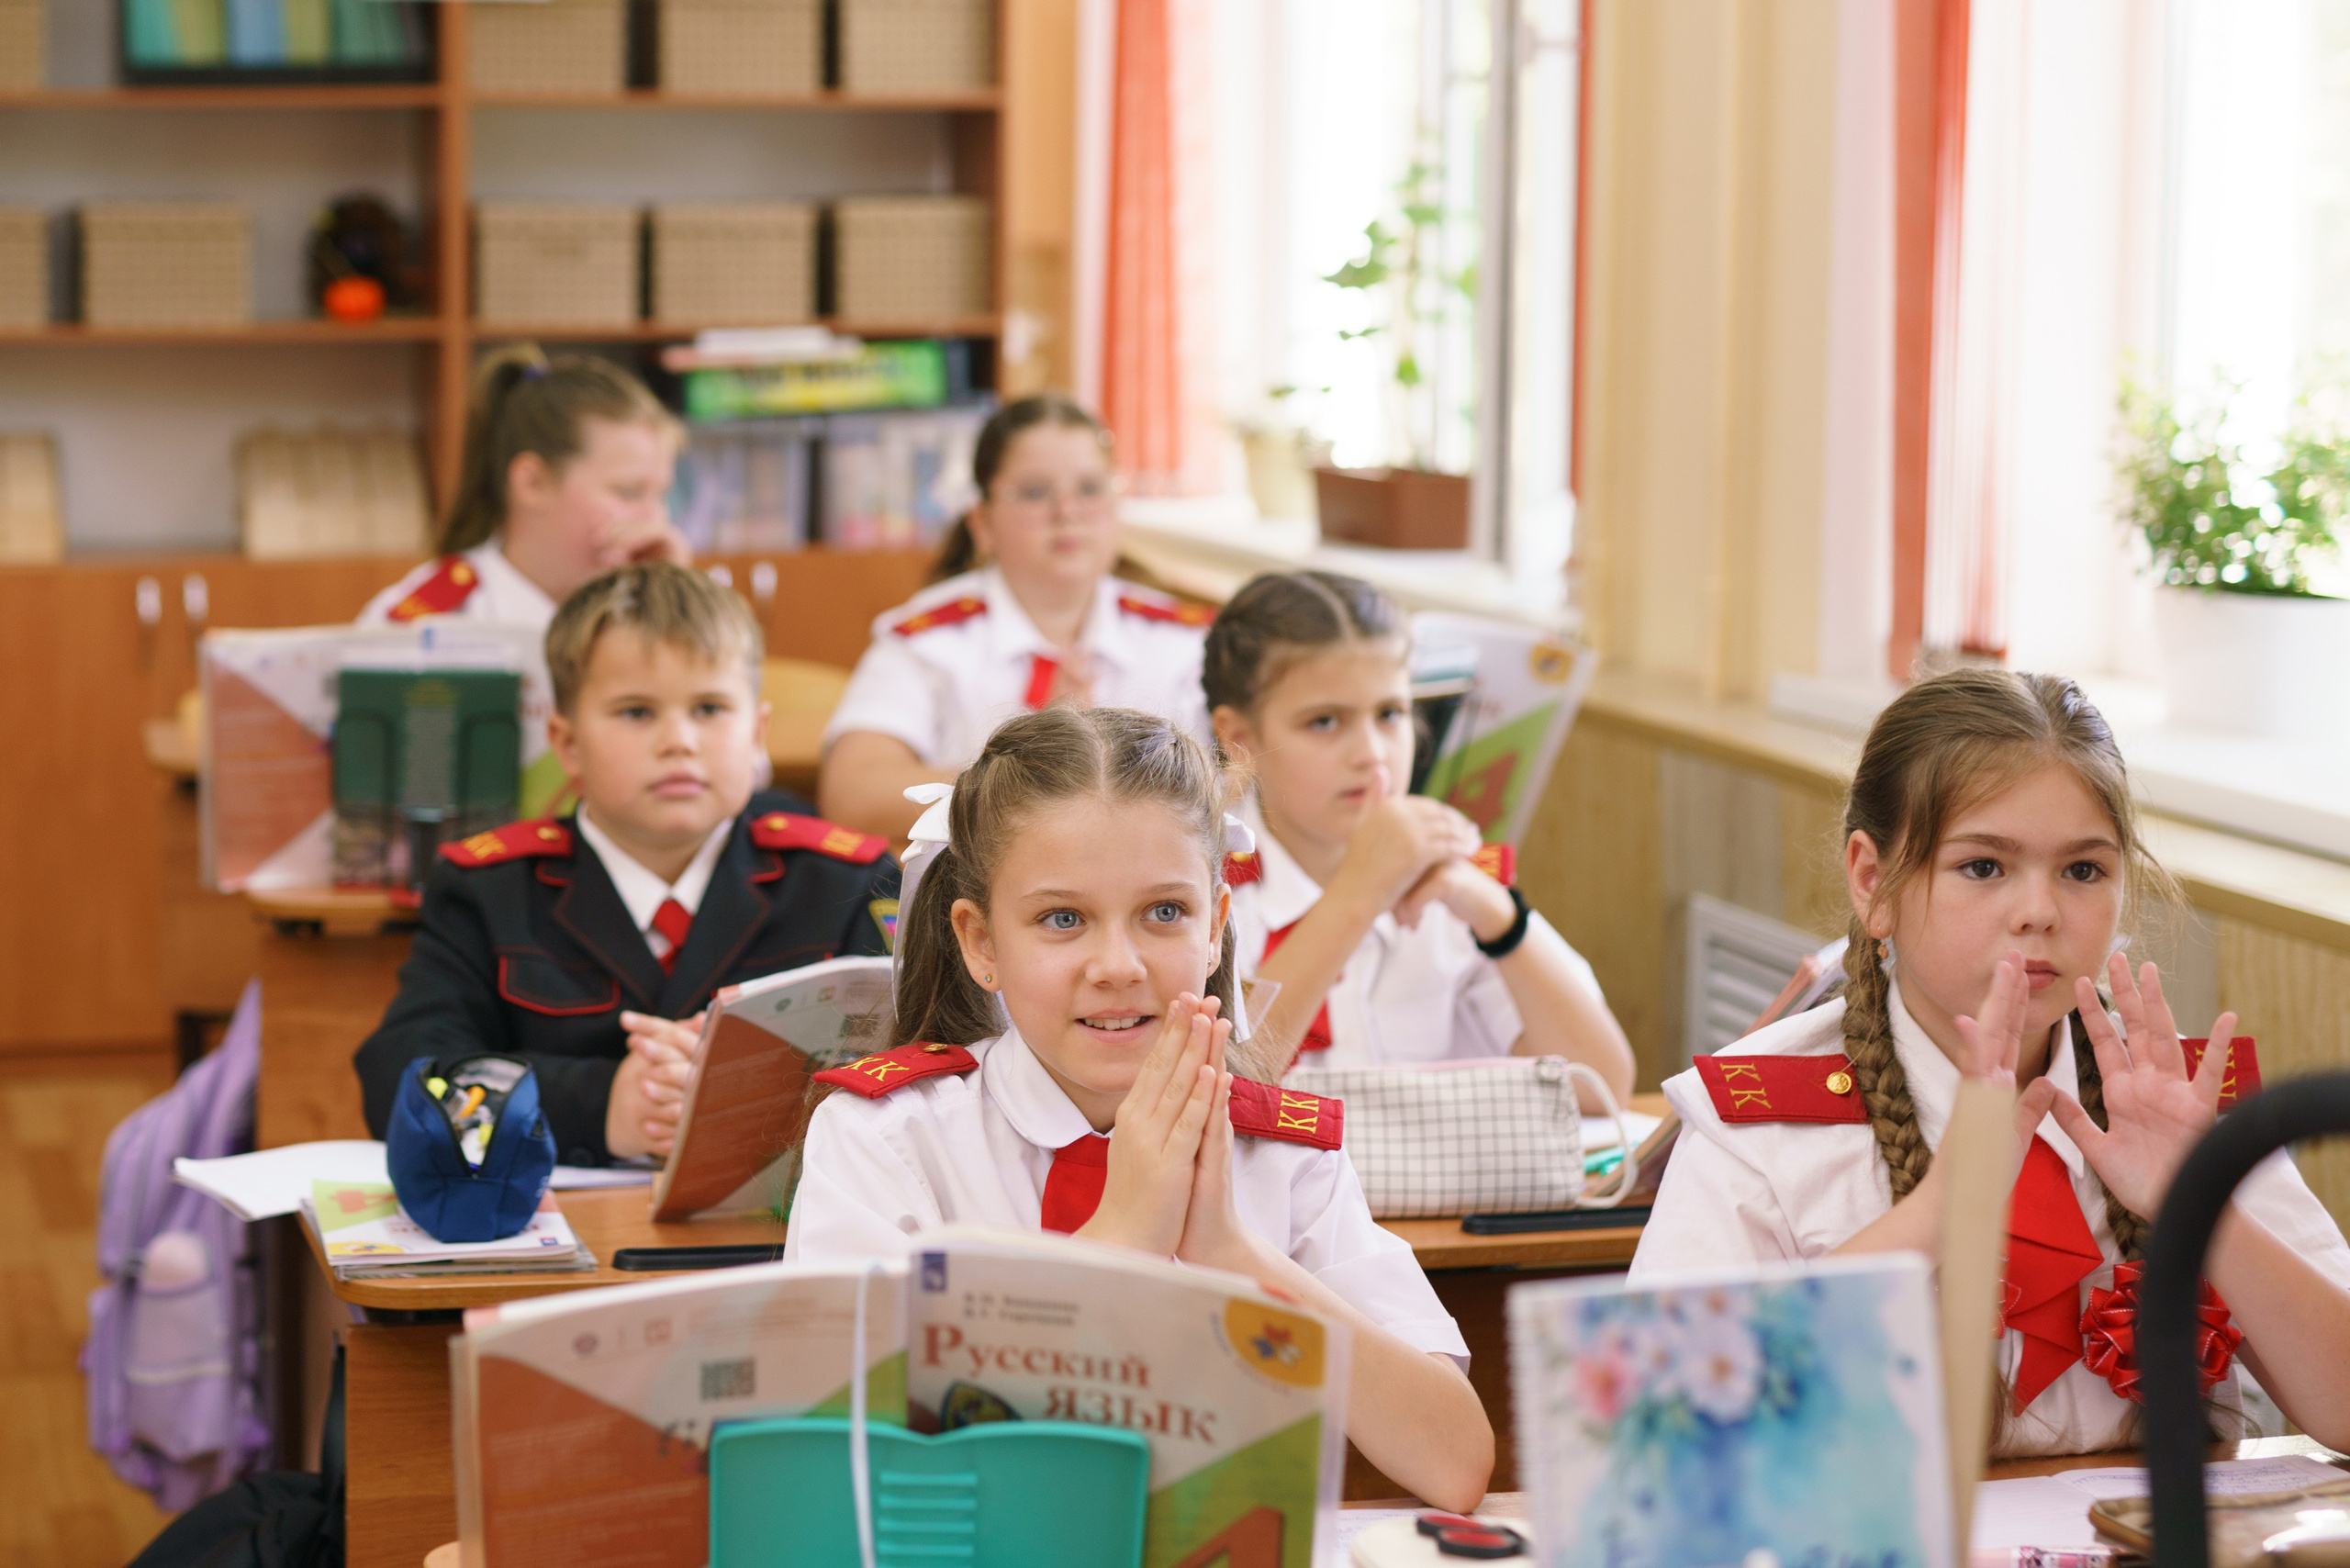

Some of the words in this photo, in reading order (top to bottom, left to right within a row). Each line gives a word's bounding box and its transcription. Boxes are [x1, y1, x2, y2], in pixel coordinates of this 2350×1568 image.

[1277, 1092, 1319, 1134] КК
[1719, 1062, 1773, 1110] КК
[920, 1322, 1150, 1390] Русский
[1046, 1385, 1219, 1447] язык
